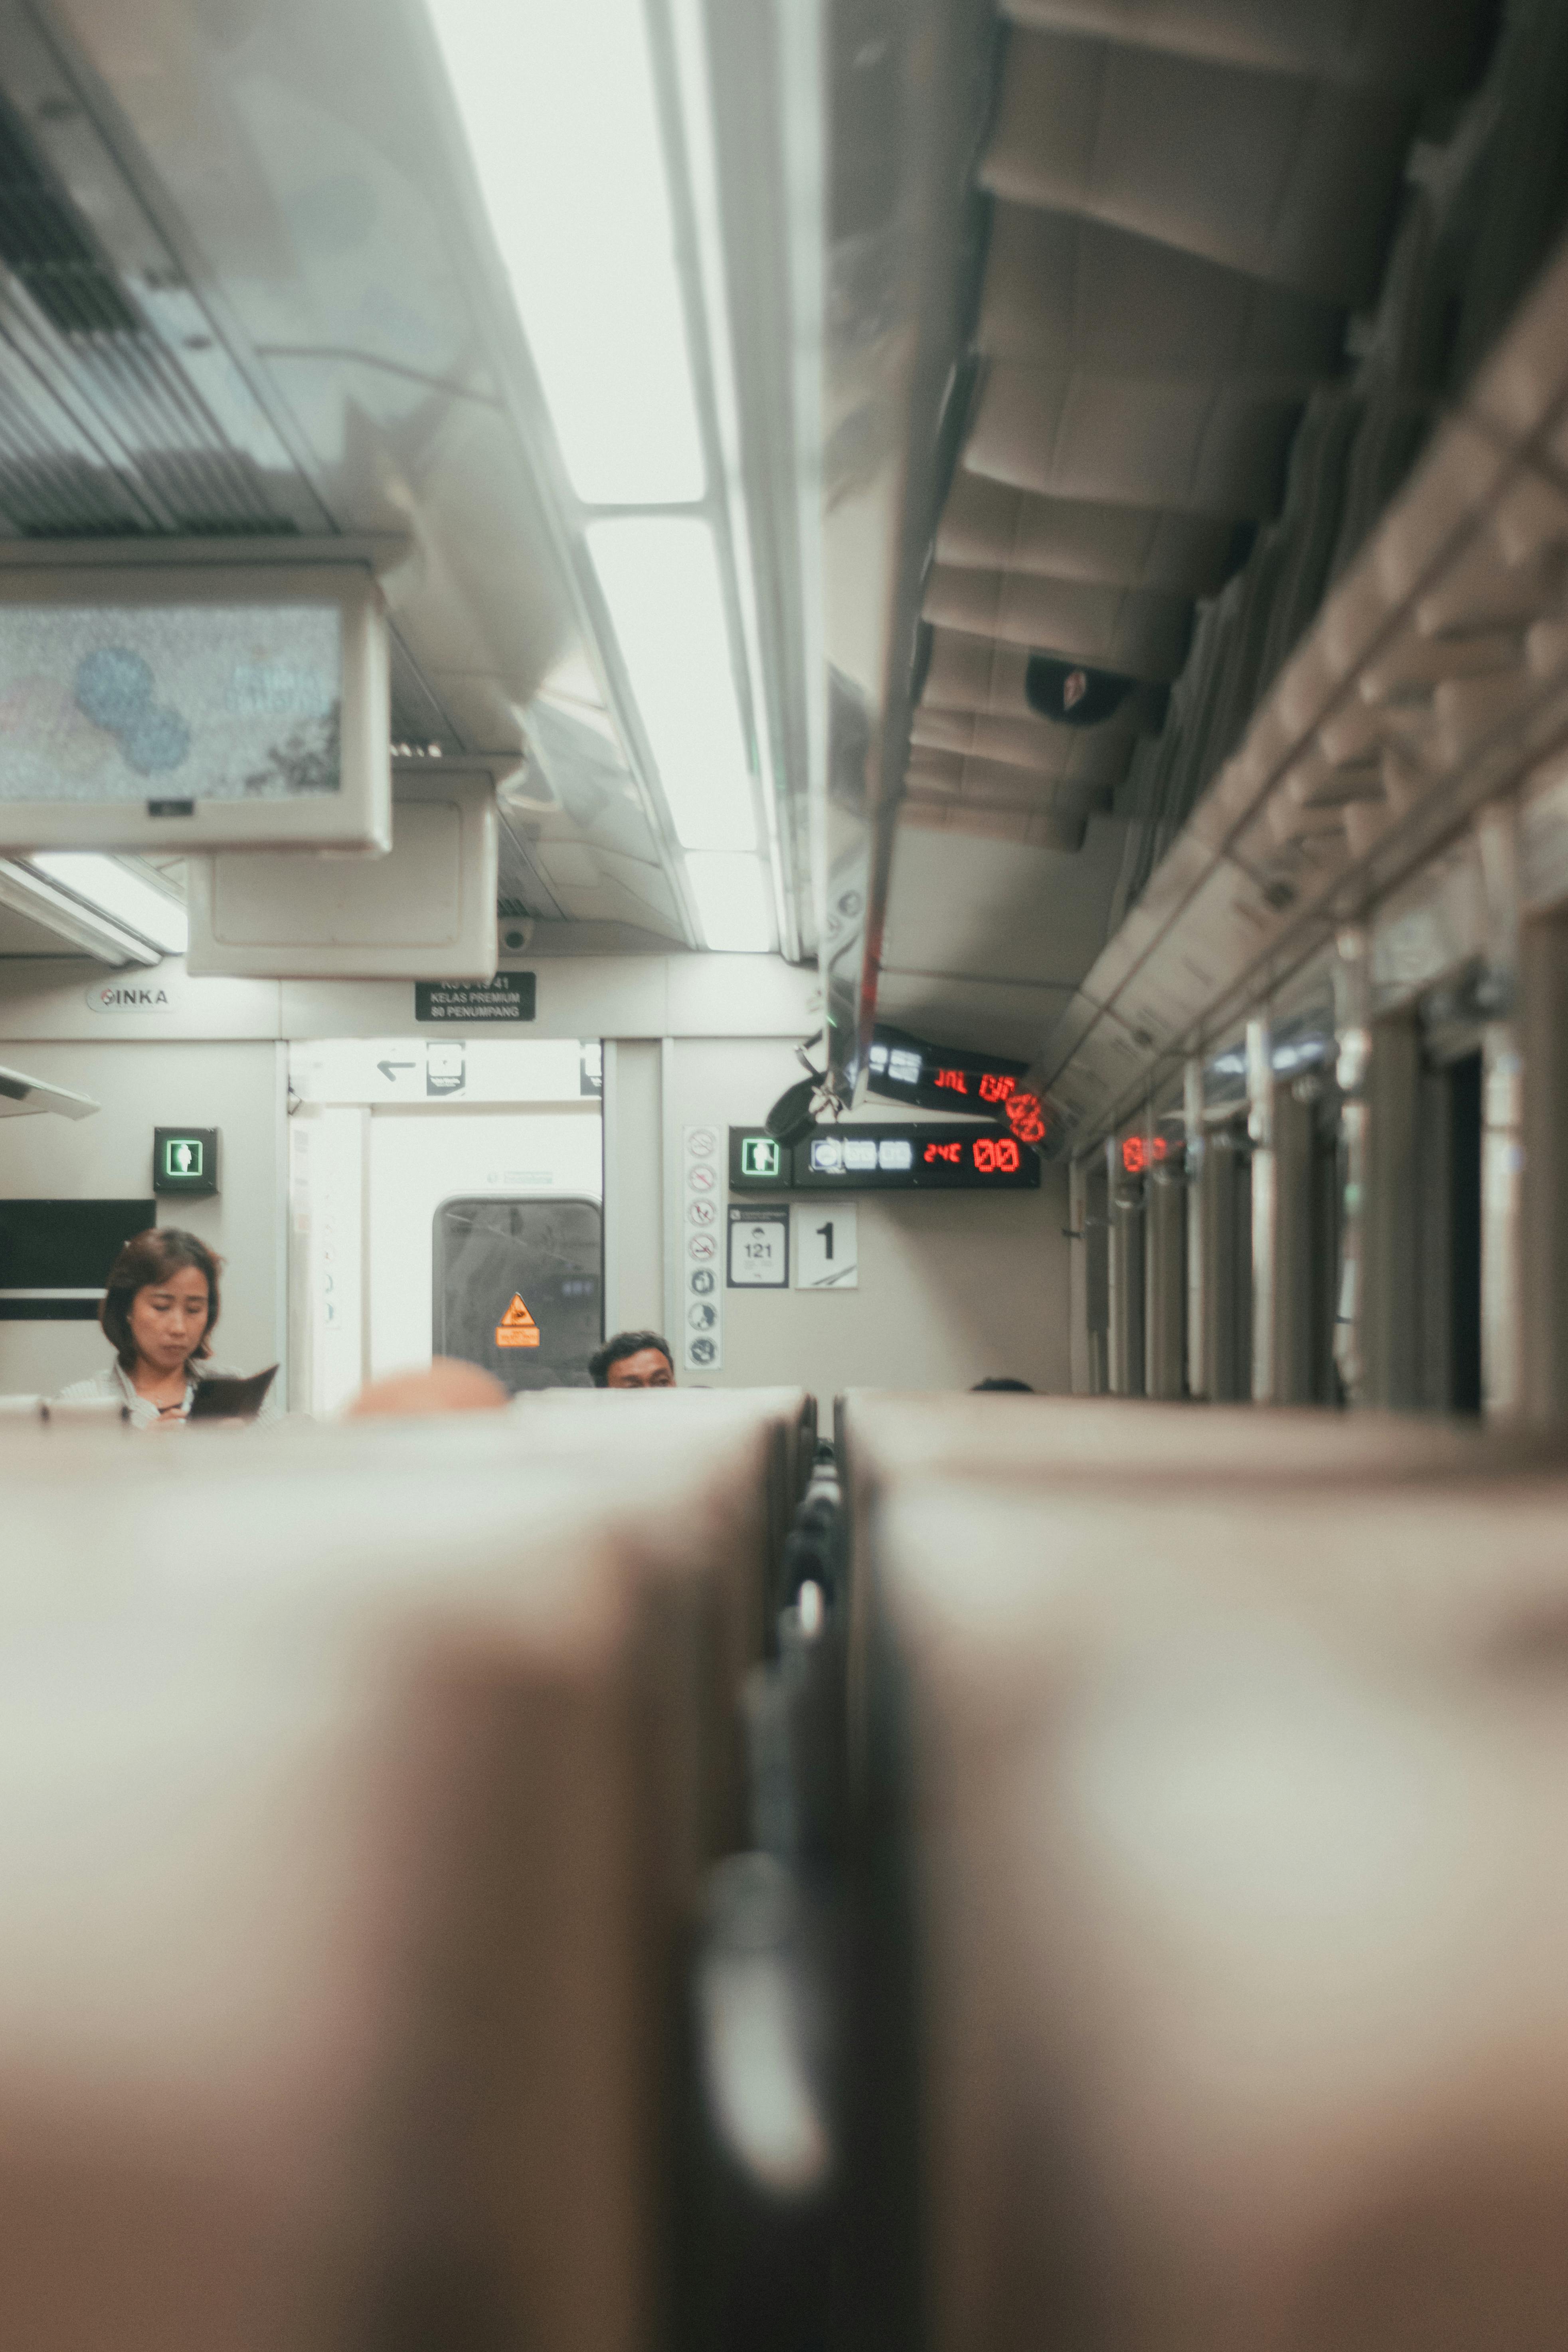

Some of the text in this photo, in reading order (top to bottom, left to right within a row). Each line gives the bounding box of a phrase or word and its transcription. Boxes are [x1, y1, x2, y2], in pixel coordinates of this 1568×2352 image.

[430, 992, 520, 1003] KELAS PREMIUM
[431, 1006, 520, 1017] 80 PENUMPANG
[973, 1138, 1020, 1173] 00
[817, 1221, 833, 1259] 1
[744, 1243, 772, 1258] 121
